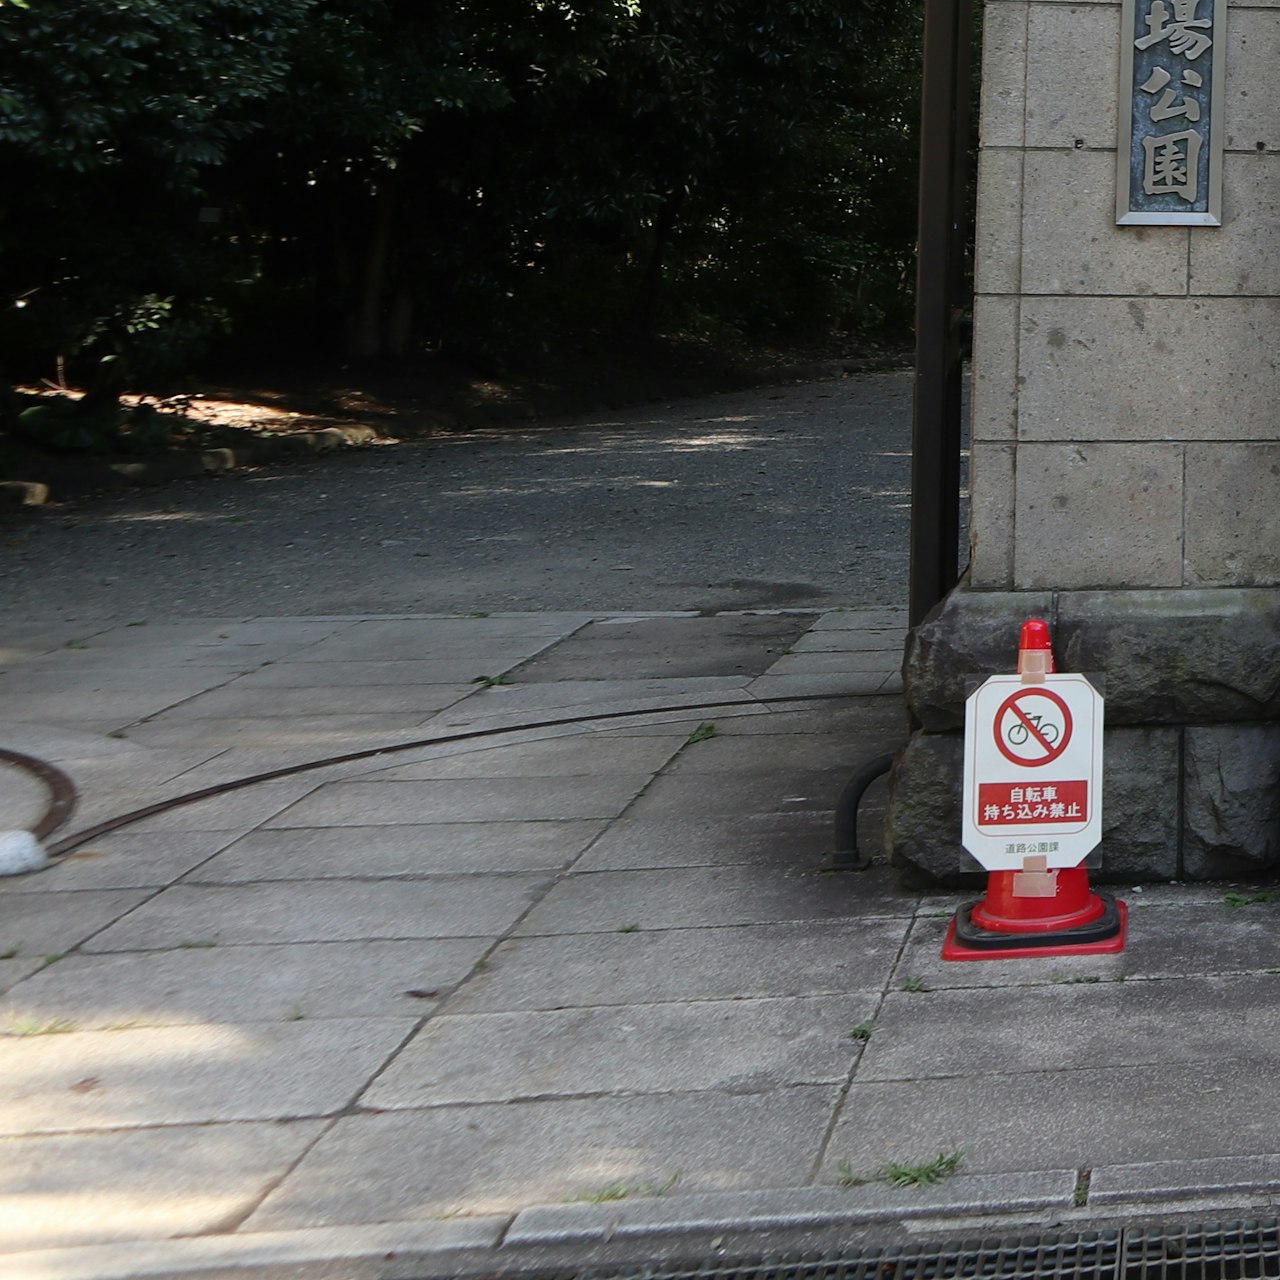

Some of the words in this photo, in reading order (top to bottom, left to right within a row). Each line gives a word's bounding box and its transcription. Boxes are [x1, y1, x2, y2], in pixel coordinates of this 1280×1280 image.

[1011, 786, 1057, 802] 自転車
[984, 803, 1081, 820] 持ち込み禁止
[1006, 841, 1059, 853] 道路公園課
